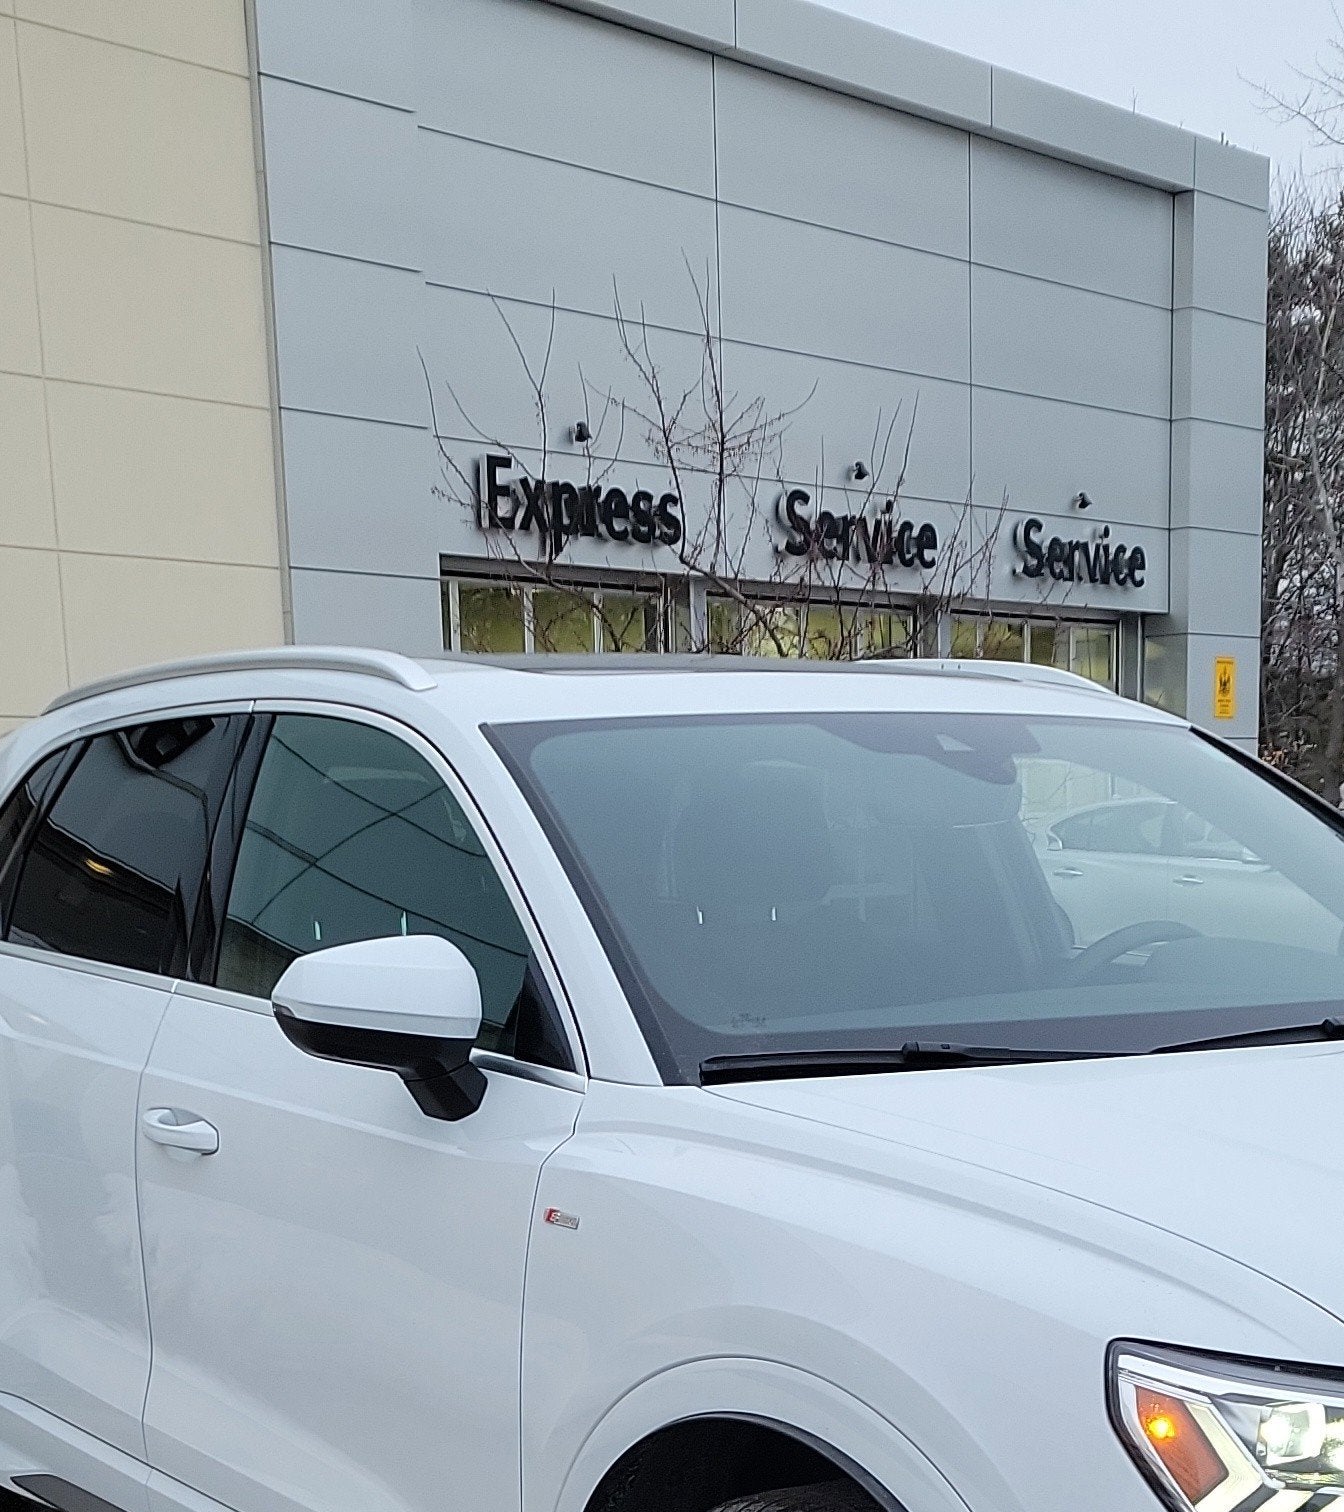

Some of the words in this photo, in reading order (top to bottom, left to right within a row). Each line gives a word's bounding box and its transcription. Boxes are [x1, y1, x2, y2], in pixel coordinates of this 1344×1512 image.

[478, 453, 682, 556] Express
[775, 488, 938, 570] Service
[1013, 517, 1147, 589] Service
